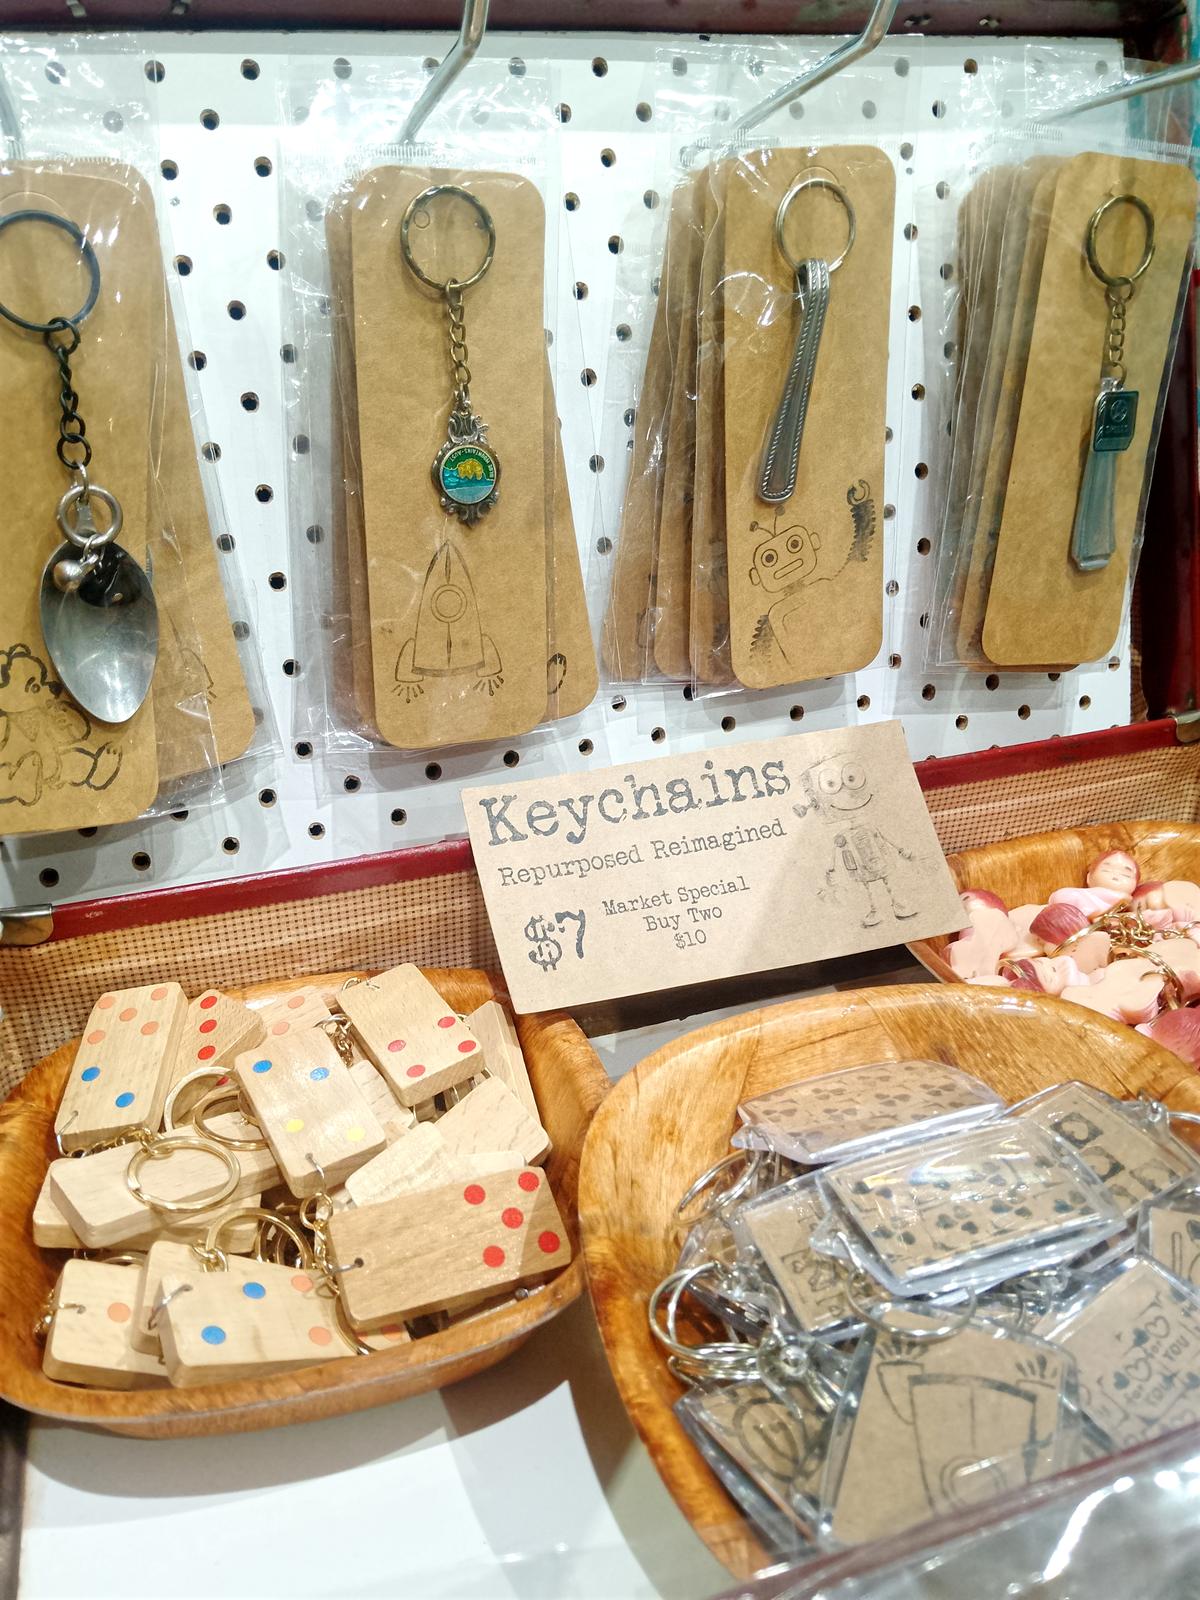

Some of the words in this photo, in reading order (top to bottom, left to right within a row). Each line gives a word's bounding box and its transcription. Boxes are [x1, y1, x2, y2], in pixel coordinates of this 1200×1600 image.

[479, 760, 792, 846] Keychains
[498, 846, 644, 886] Repurposed
[653, 818, 788, 859] Reimagined
[602, 890, 673, 916] Market
[678, 876, 751, 905] Special
[643, 912, 681, 934] Buy
[688, 905, 723, 927] Two
[524, 909, 588, 973] $7
[674, 928, 708, 949] $10
